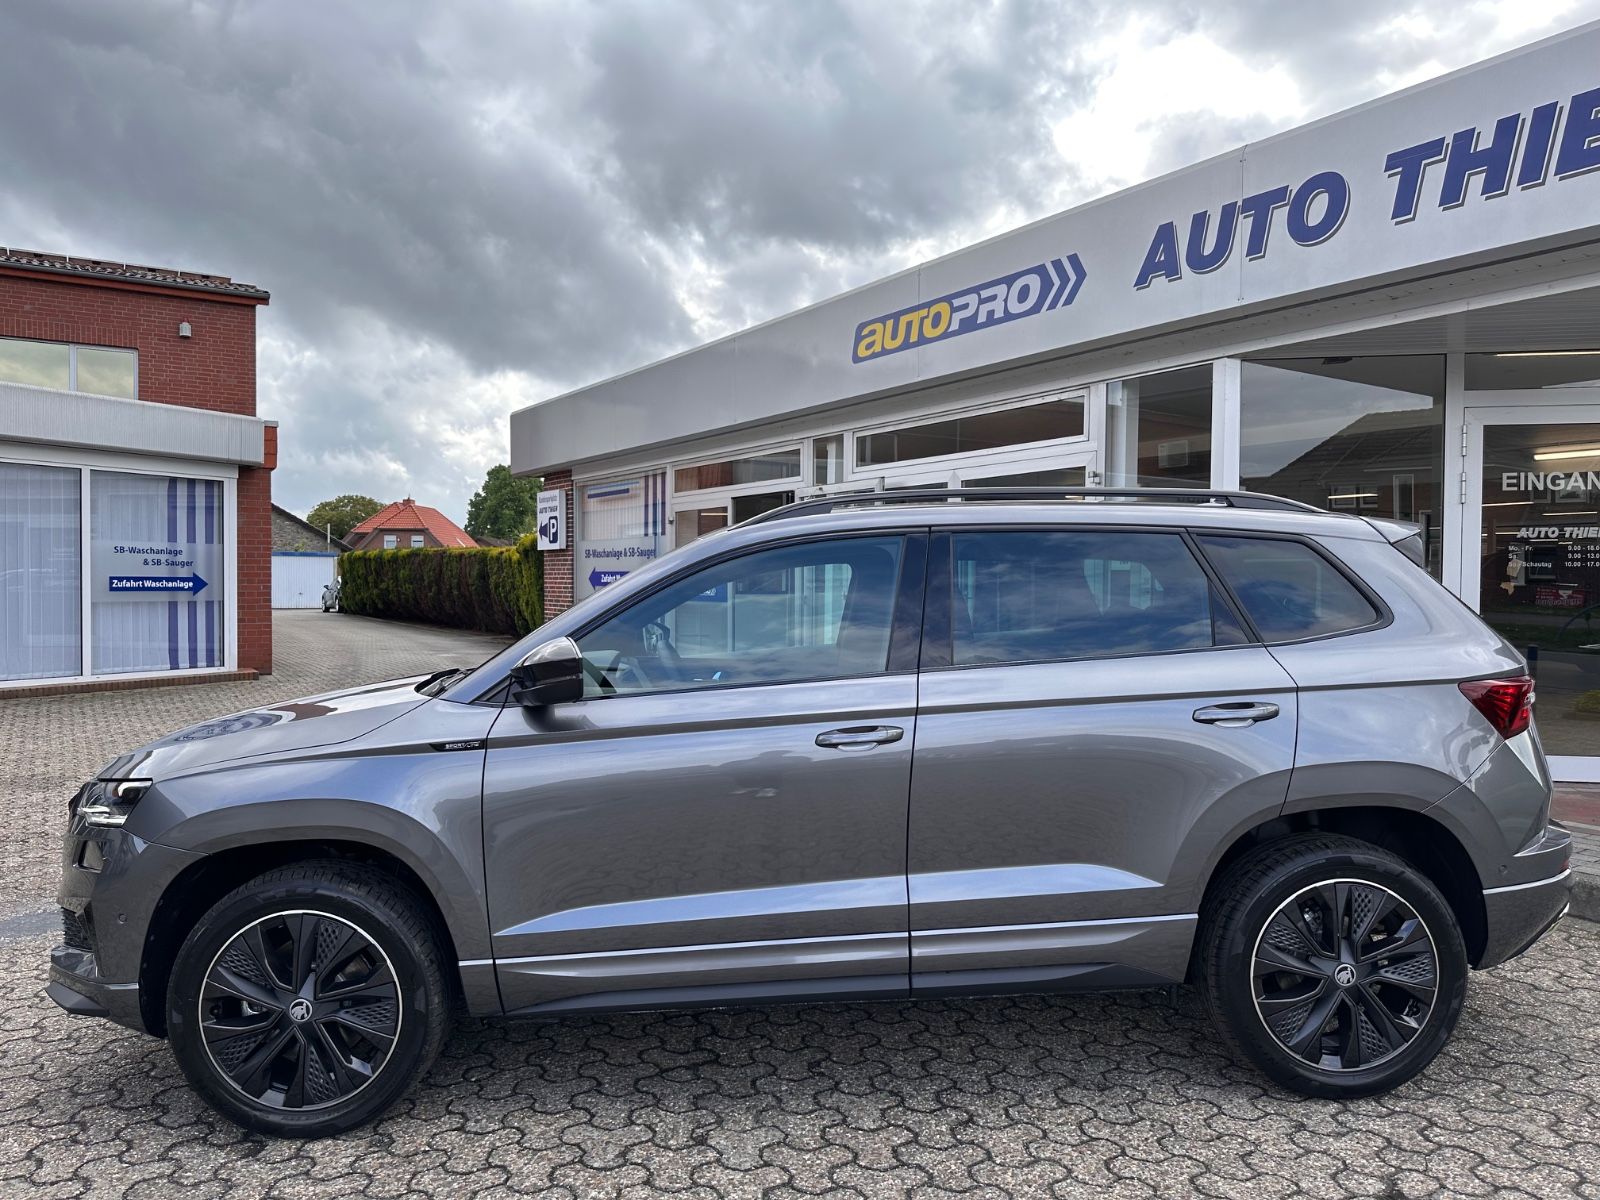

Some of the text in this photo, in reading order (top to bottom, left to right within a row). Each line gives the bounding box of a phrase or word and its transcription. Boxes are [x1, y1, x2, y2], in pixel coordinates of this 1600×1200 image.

[1134, 171, 1349, 290] AUTO
[1516, 527, 1559, 538] AUTO
[113, 545, 183, 557] SB-Waschanlage
[584, 548, 623, 560] SB-Waschanlage
[143, 558, 194, 568] & SB-Sauger
[112, 579, 194, 589] Zufahrt Waschanlage
